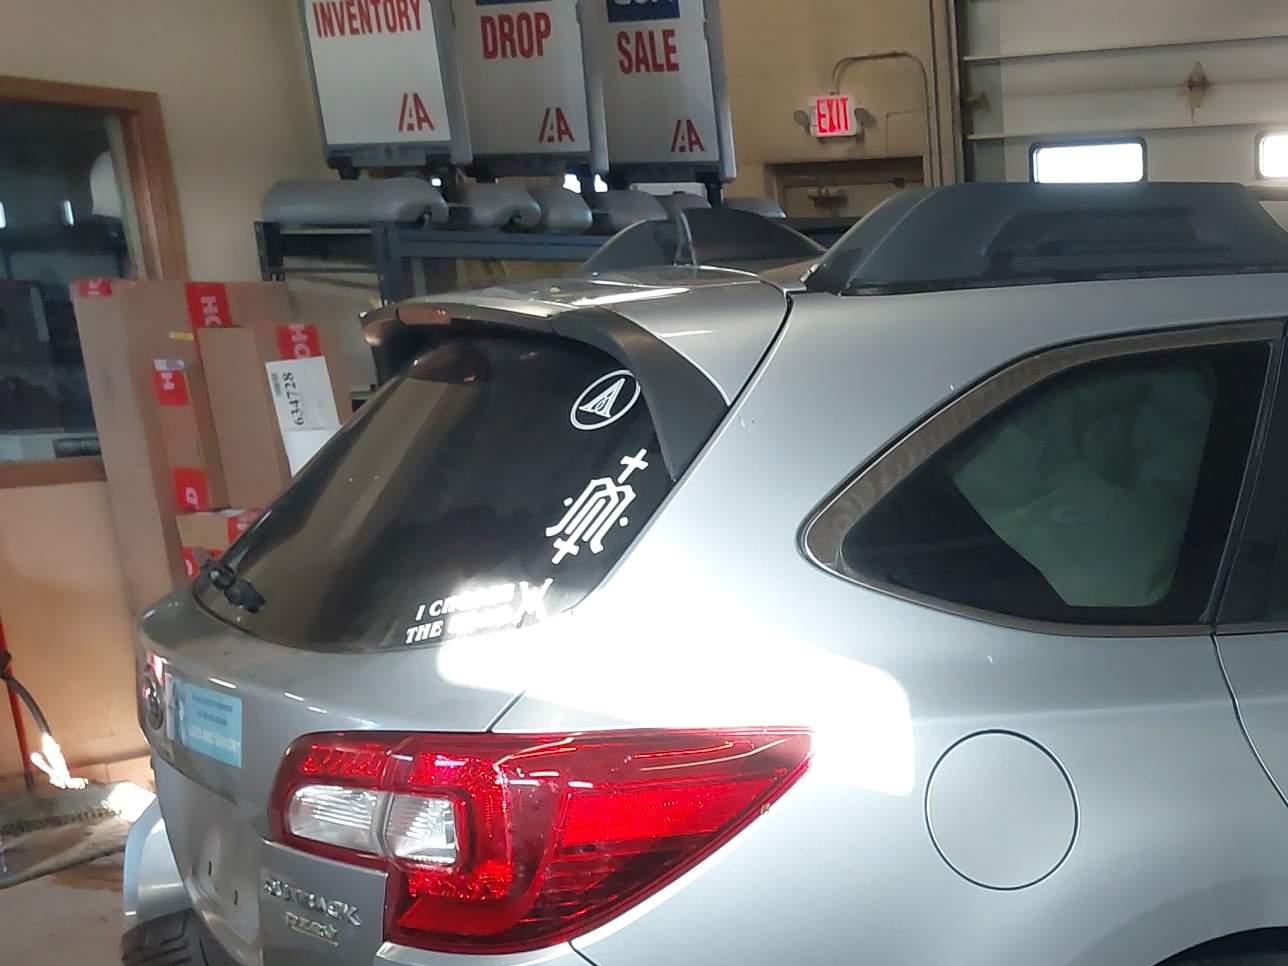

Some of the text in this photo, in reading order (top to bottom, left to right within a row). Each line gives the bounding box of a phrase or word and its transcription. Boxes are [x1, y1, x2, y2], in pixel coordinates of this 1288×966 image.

[312, 0, 422, 38] INVENTORY
[480, 12, 551, 60] DROP
[617, 29, 680, 75] SALE
[816, 97, 849, 133] EXIT
[282, 372, 305, 426] 634728
[415, 604, 426, 621] I
[405, 620, 444, 644] THE
